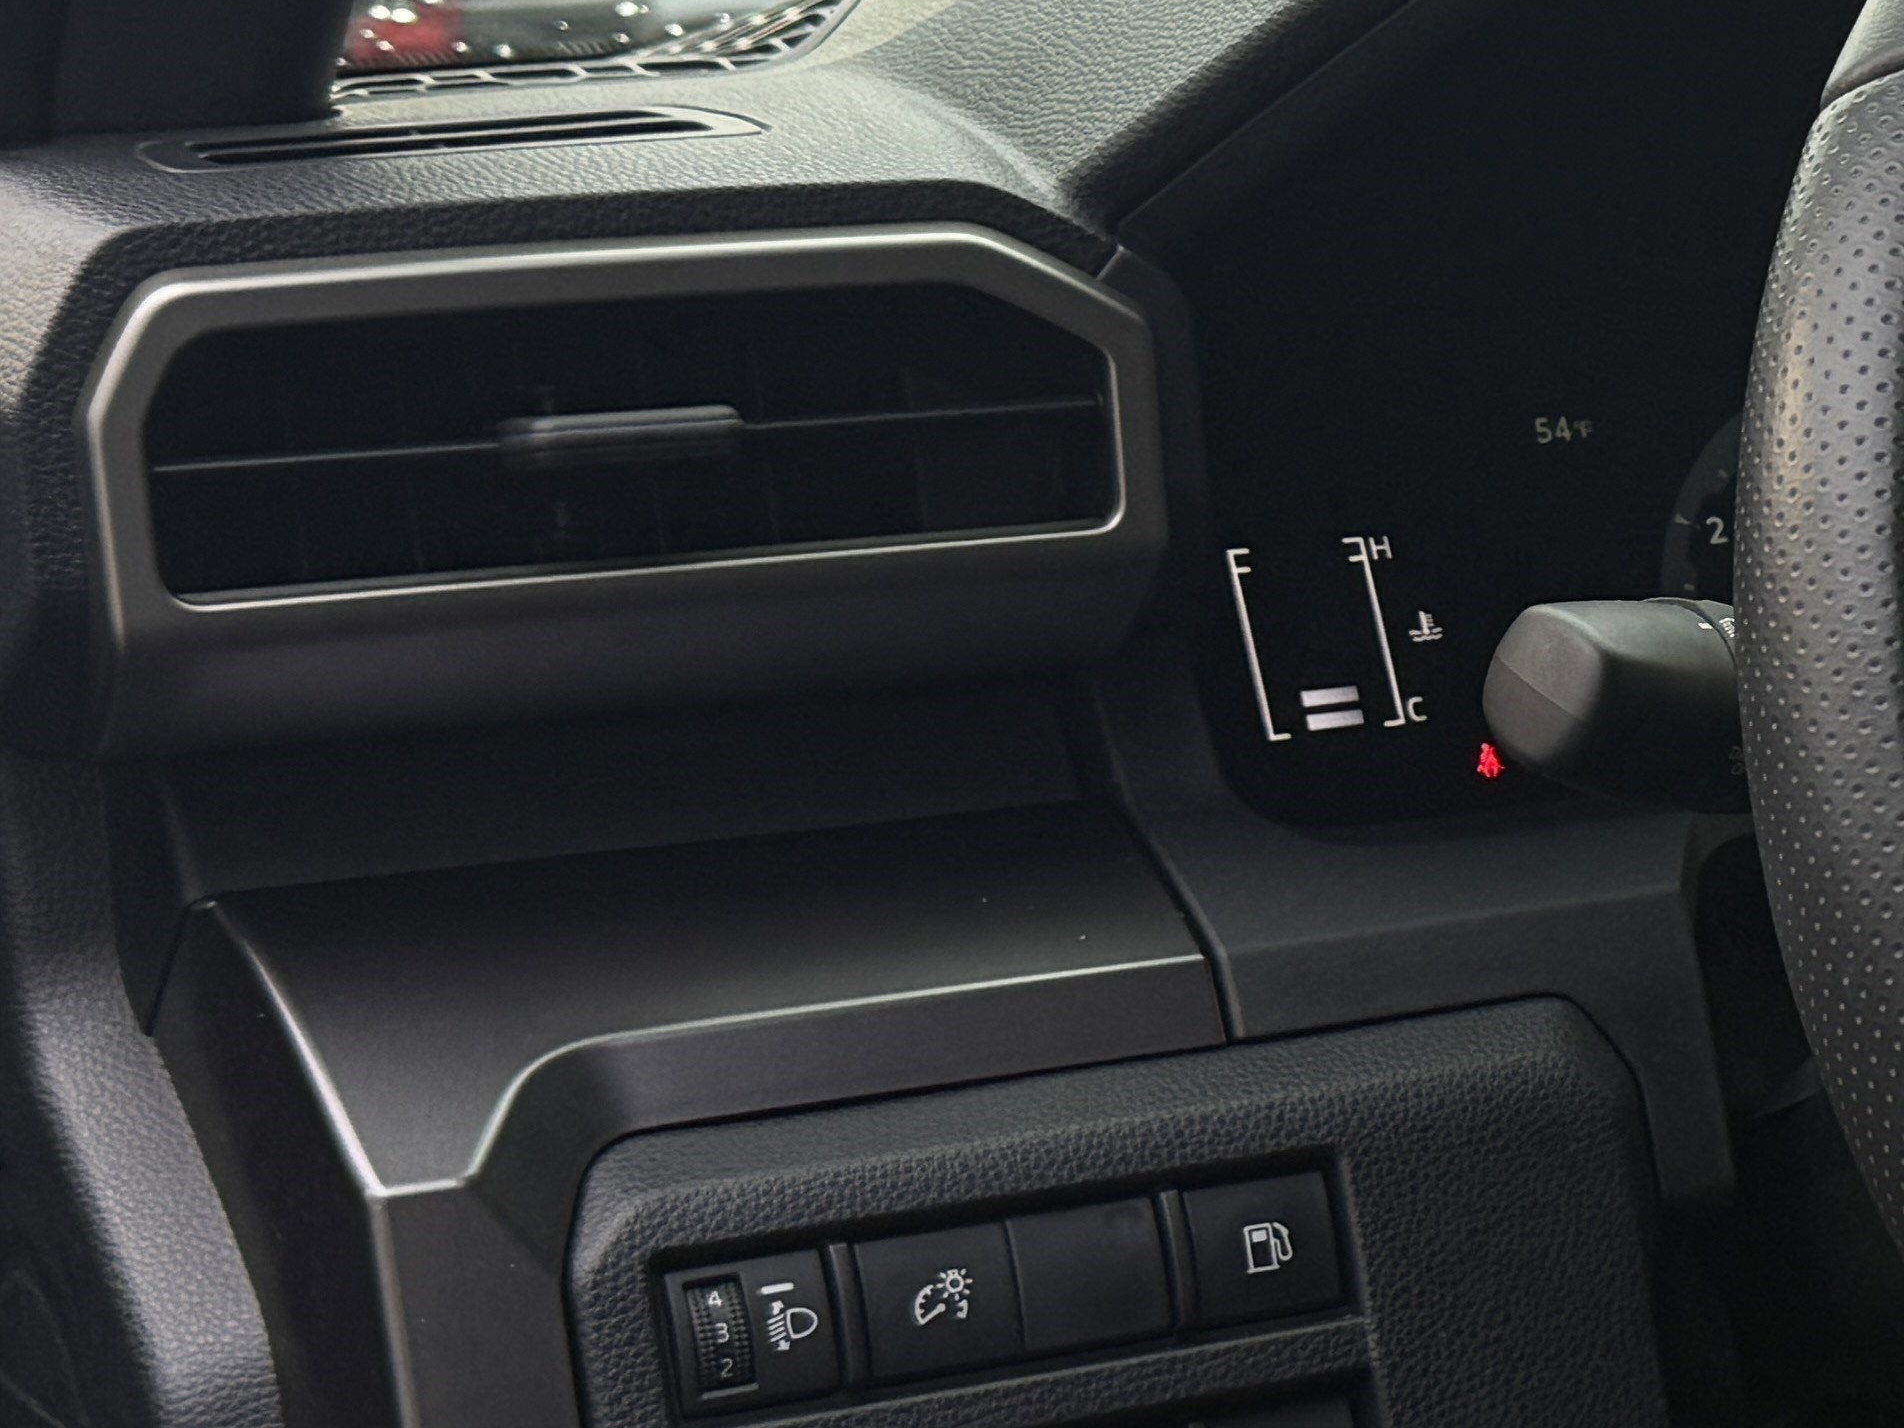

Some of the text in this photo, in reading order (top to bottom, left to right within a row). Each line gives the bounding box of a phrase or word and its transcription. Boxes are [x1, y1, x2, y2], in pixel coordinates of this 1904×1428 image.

[1703, 516, 1729, 545] 2
[1368, 535, 1392, 560] H
[1406, 696, 1428, 723] C
[707, 1290, 723, 1308] 4
[715, 1321, 731, 1344] 3
[720, 1358, 734, 1379] 2
